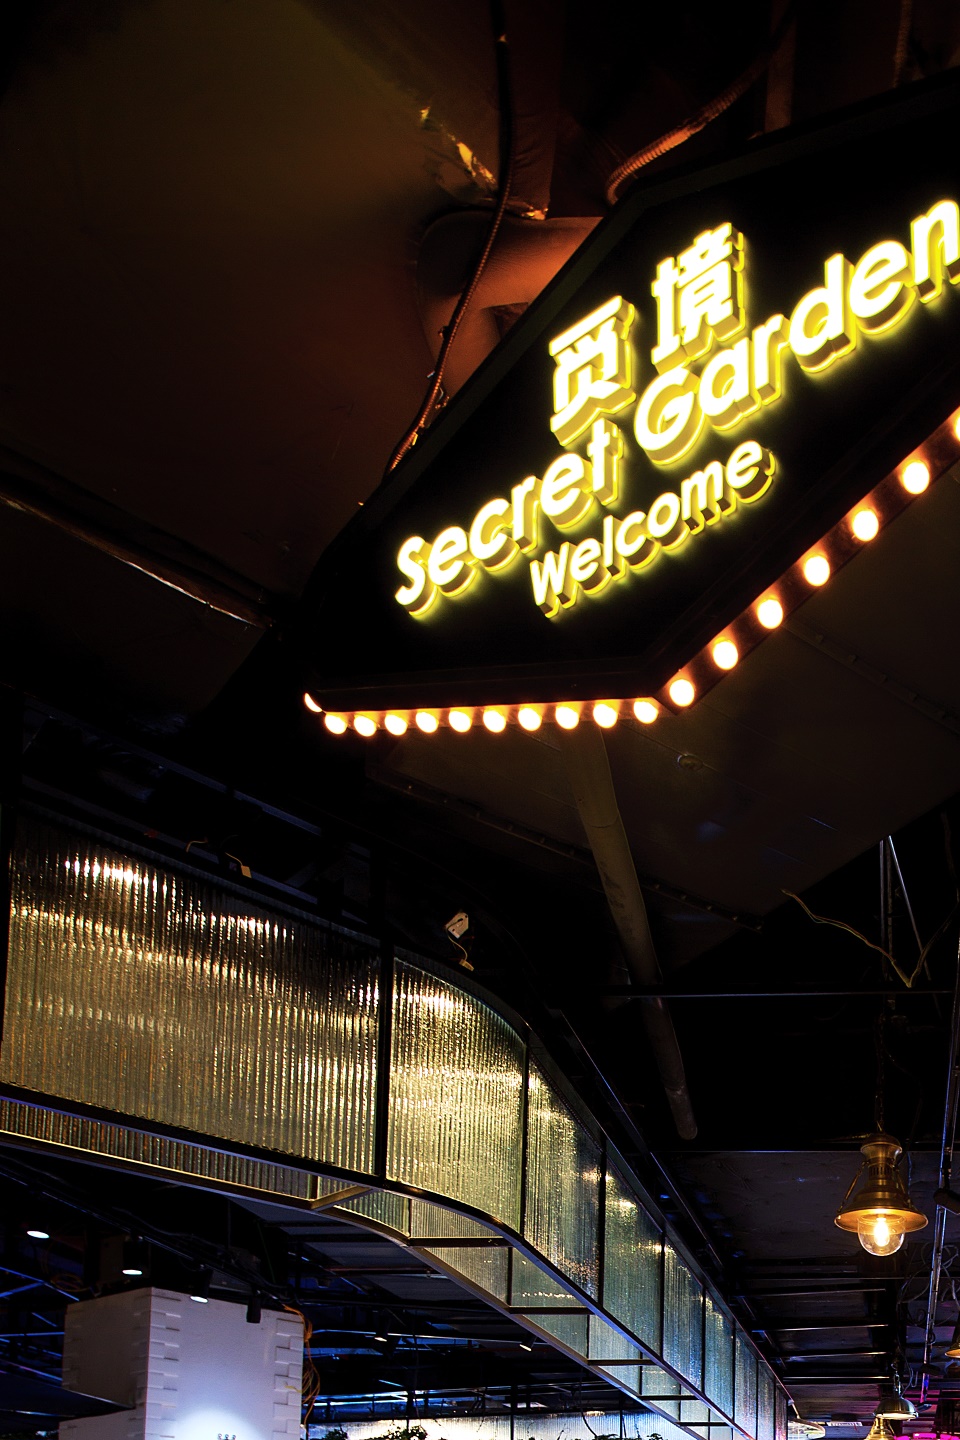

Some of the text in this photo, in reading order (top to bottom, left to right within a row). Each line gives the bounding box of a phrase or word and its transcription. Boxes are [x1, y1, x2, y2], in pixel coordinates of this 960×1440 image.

[549, 222, 745, 446] 觅境
[395, 417, 622, 616] Secret
[529, 440, 776, 618] Welcome
